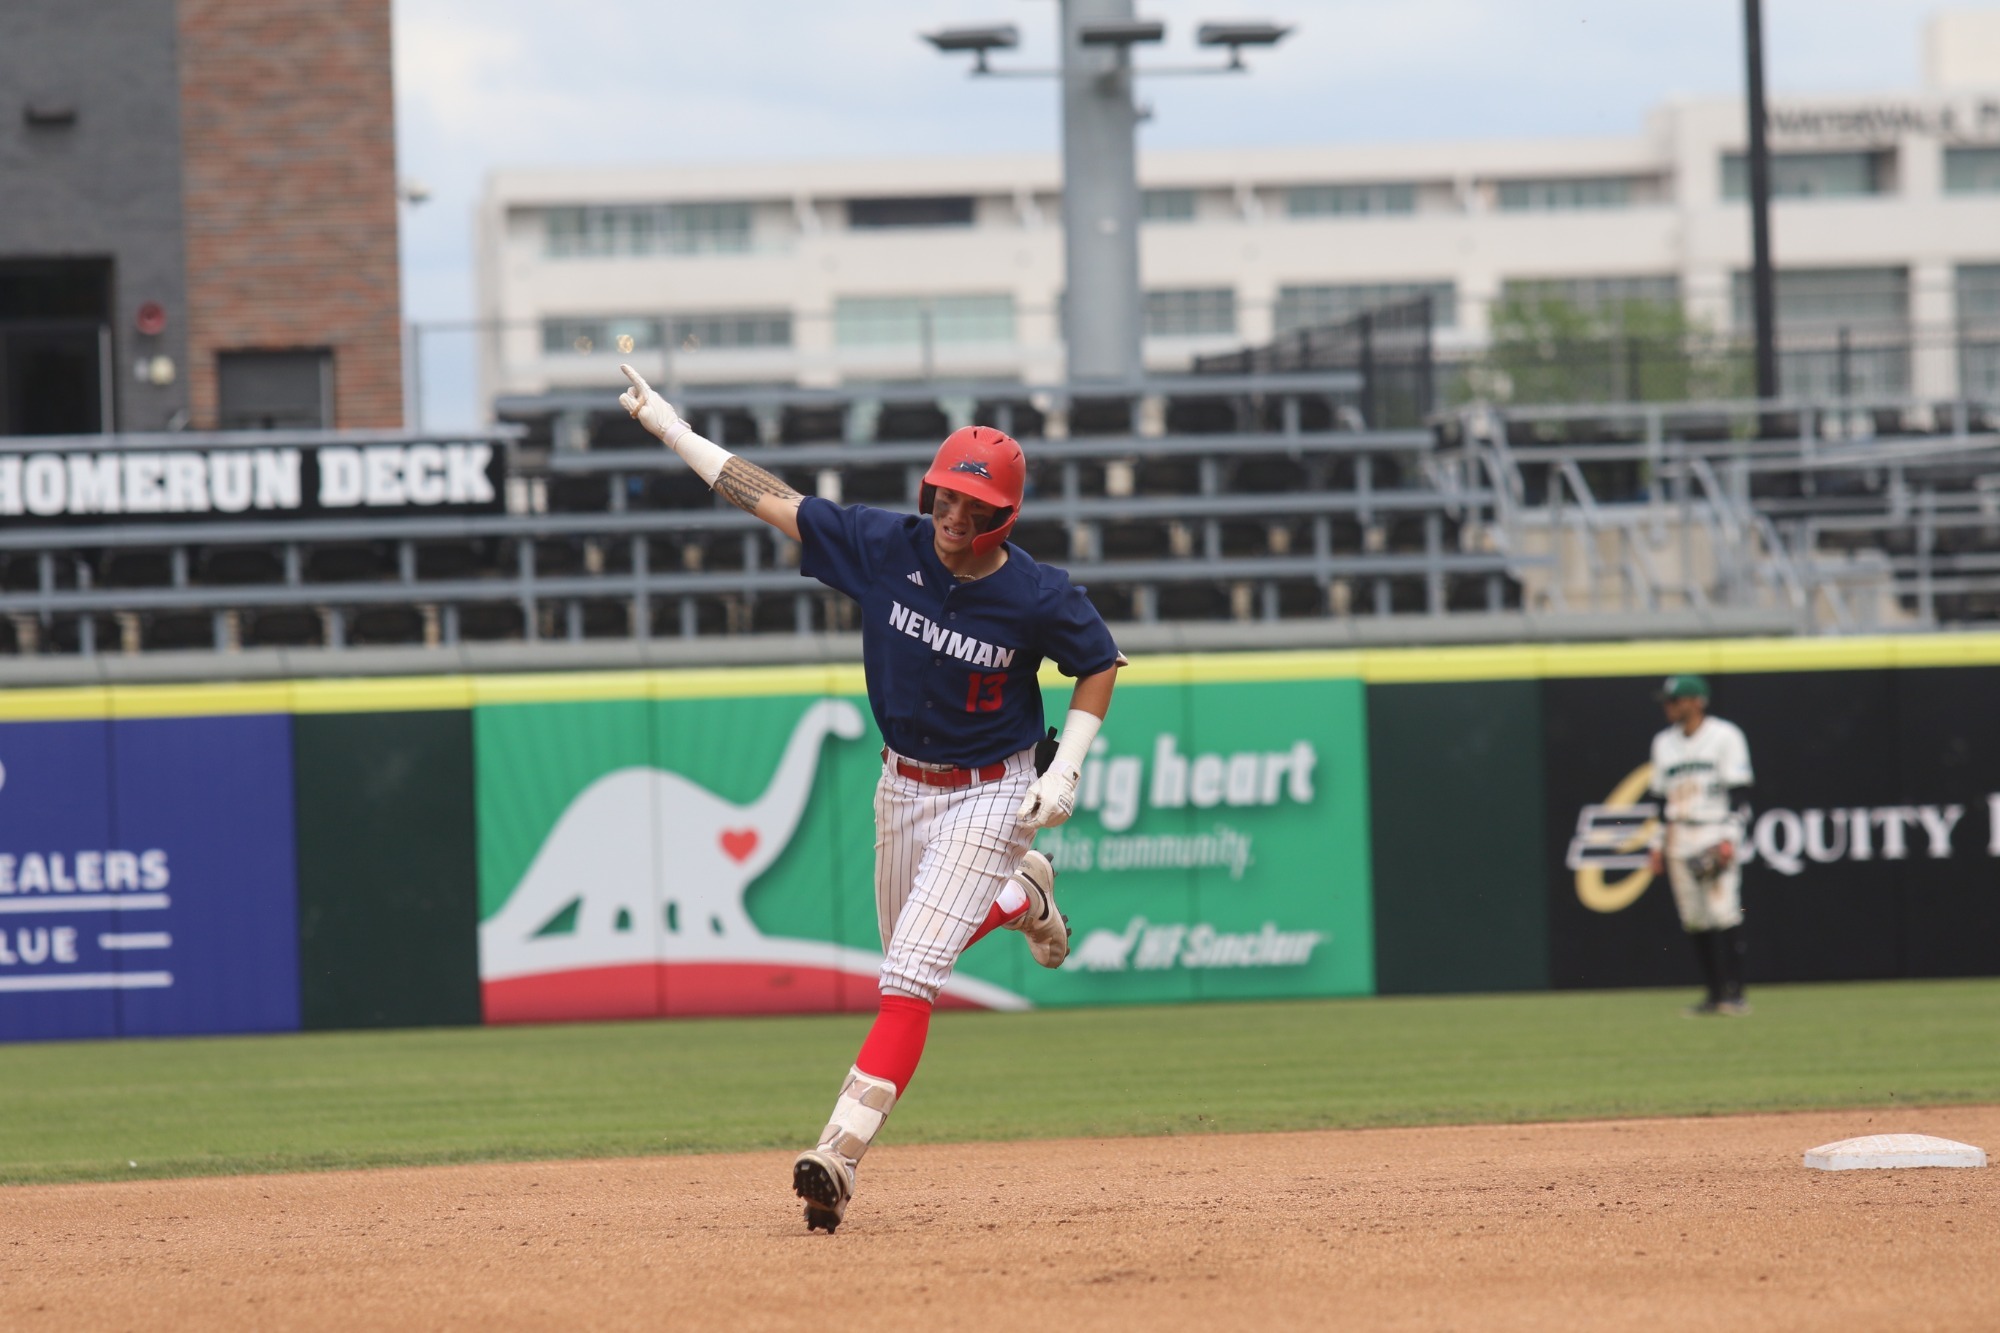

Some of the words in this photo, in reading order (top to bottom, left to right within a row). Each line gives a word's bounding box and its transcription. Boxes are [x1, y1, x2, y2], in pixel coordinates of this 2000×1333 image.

[317, 443, 495, 507] DECK
[889, 600, 1016, 669] NEWMAN
[965, 672, 1008, 713] 13
[1072, 734, 1142, 831] ig
[1151, 733, 1315, 808] heart
[1740, 803, 1965, 876] QUITY
